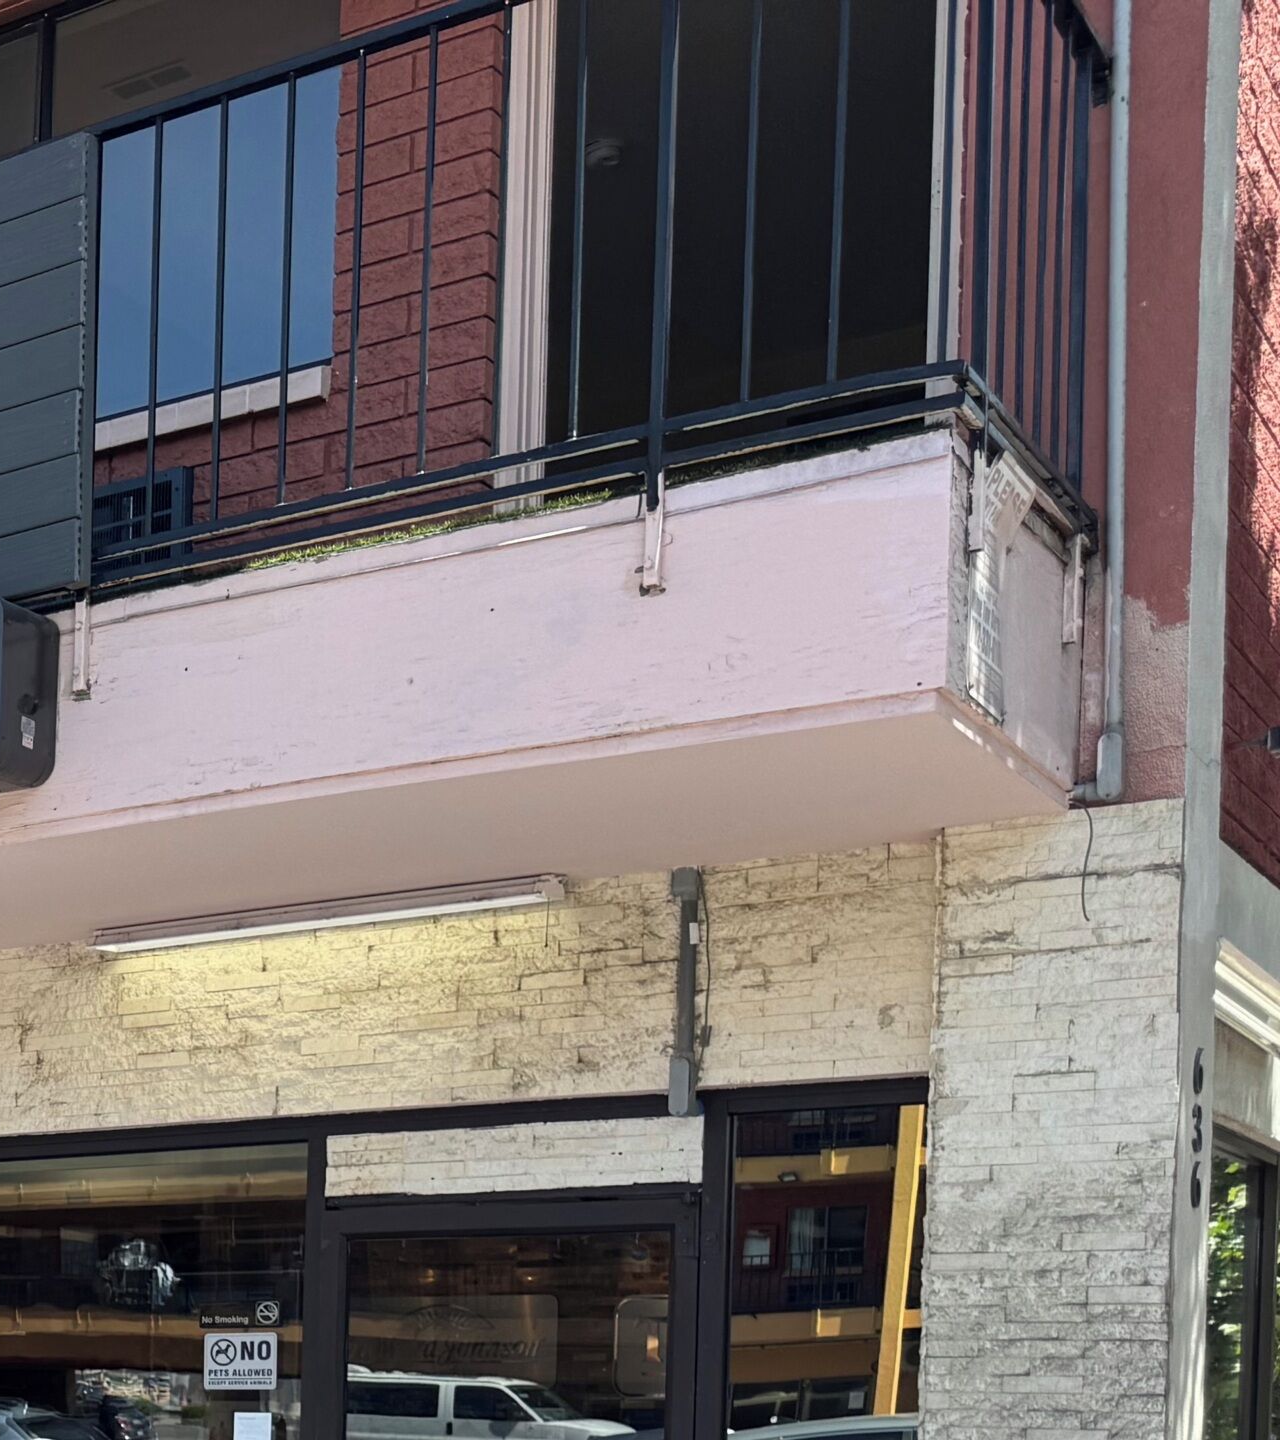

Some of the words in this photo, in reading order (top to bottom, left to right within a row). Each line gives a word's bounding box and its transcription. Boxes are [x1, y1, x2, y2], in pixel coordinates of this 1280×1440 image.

[1189, 1047, 1205, 1209] 636
[201, 1315, 213, 1324] No
[214, 1315, 249, 1326] Smoking
[240, 1340, 272, 1361] NO
[208, 1369, 229, 1377] PETS
[232, 1368, 273, 1377] ALLOWED
